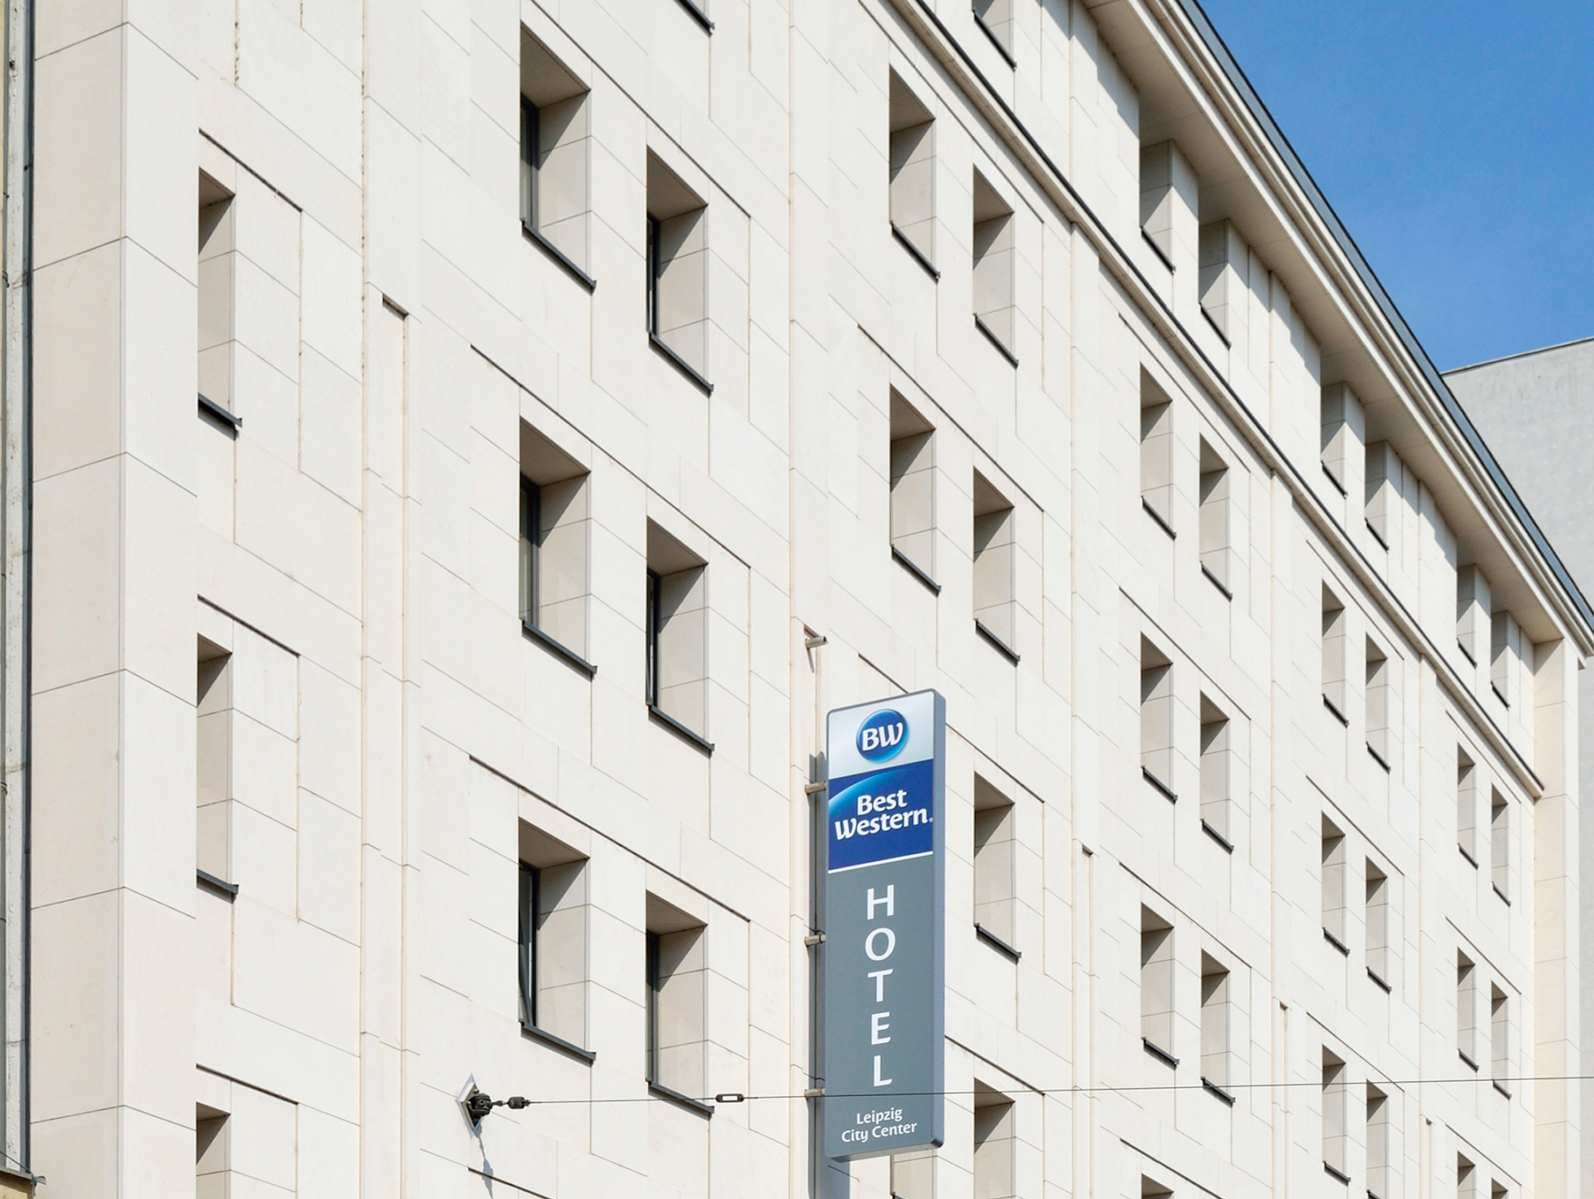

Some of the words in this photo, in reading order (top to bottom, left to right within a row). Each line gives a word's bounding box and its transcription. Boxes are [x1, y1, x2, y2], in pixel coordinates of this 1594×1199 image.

[861, 721, 904, 752] BW
[856, 788, 908, 816] Best
[864, 884, 896, 1088] HOTEL
[856, 1106, 903, 1125] Leipzig
[841, 1128, 869, 1143] City
[872, 1122, 918, 1138] Center
